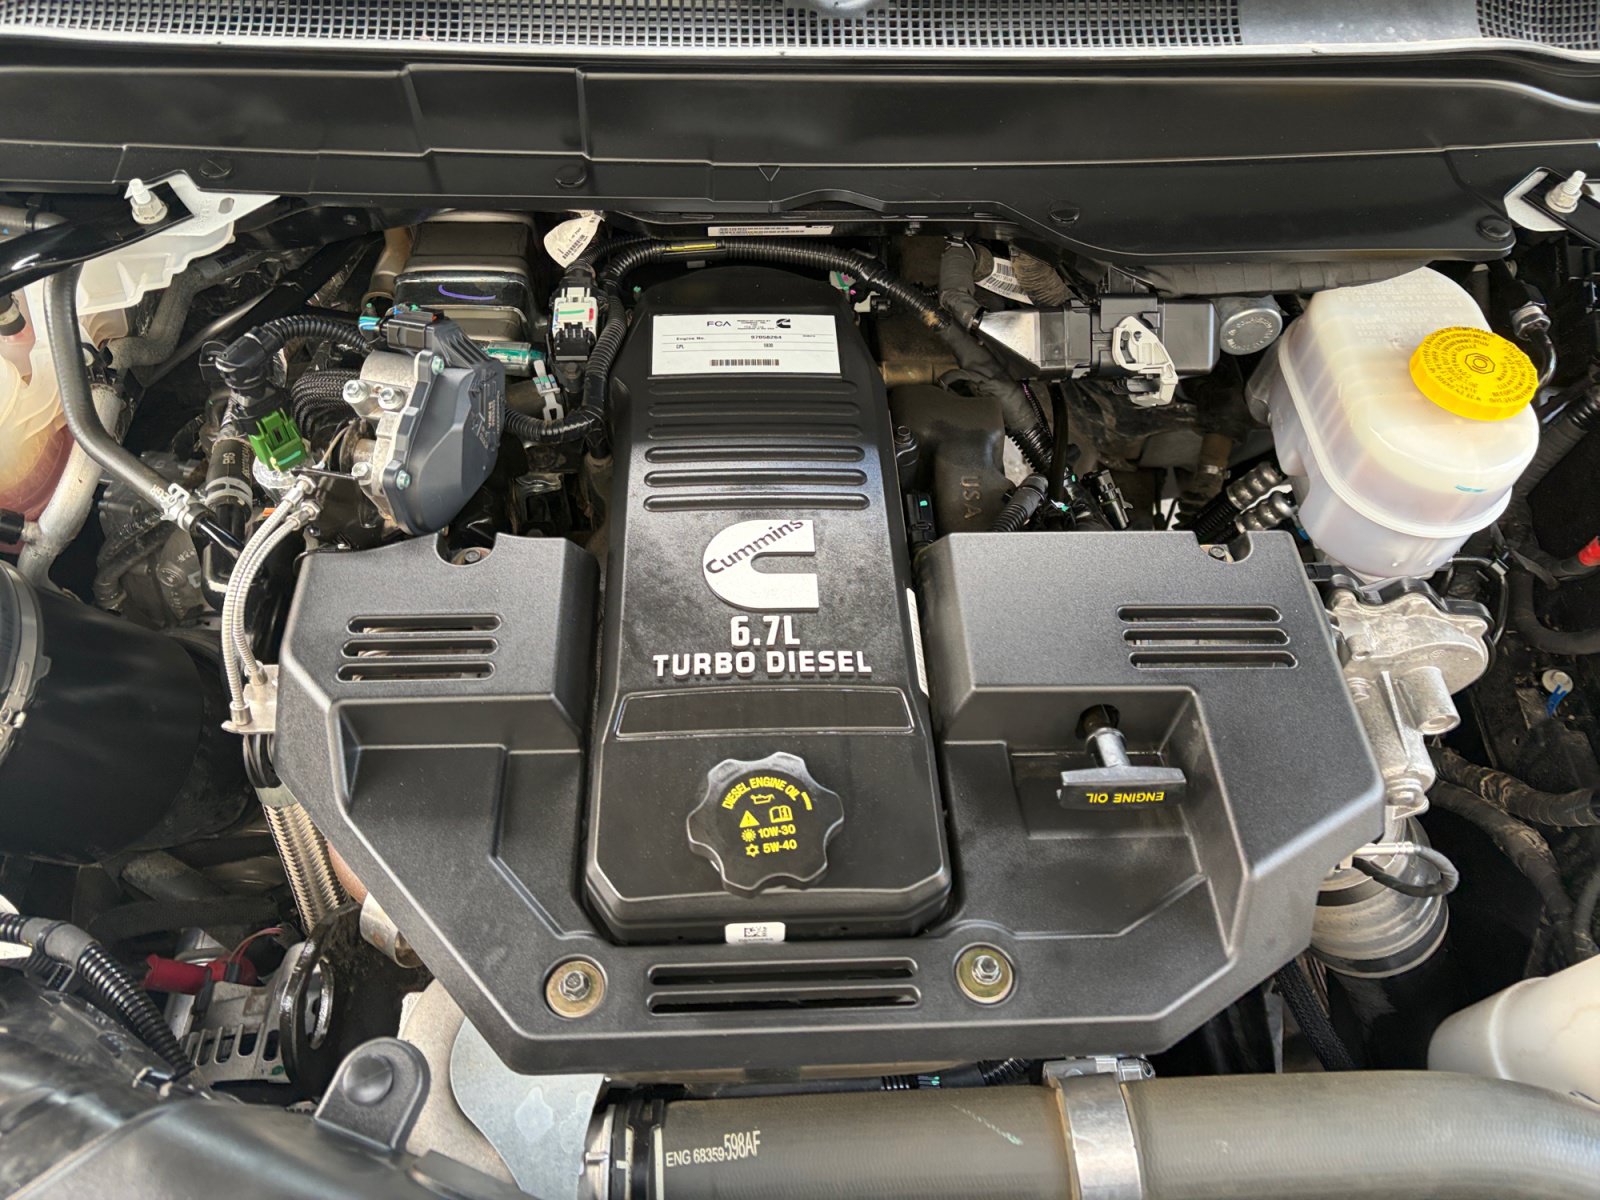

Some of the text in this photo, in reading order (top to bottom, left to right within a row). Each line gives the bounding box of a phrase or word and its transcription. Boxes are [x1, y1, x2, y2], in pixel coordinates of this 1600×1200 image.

[961, 475, 982, 519] USA
[705, 519, 804, 574] Cummins
[730, 615, 801, 648] 6.7L
[652, 650, 873, 678] TURBO DIESEL
[721, 776, 800, 810] DIESEL ENGINE OIL
[1086, 791, 1165, 804] ENGINE OIL
[758, 823, 796, 839] 10W-30
[762, 839, 797, 854] 5W-40
[665, 1148, 691, 1168] ENG
